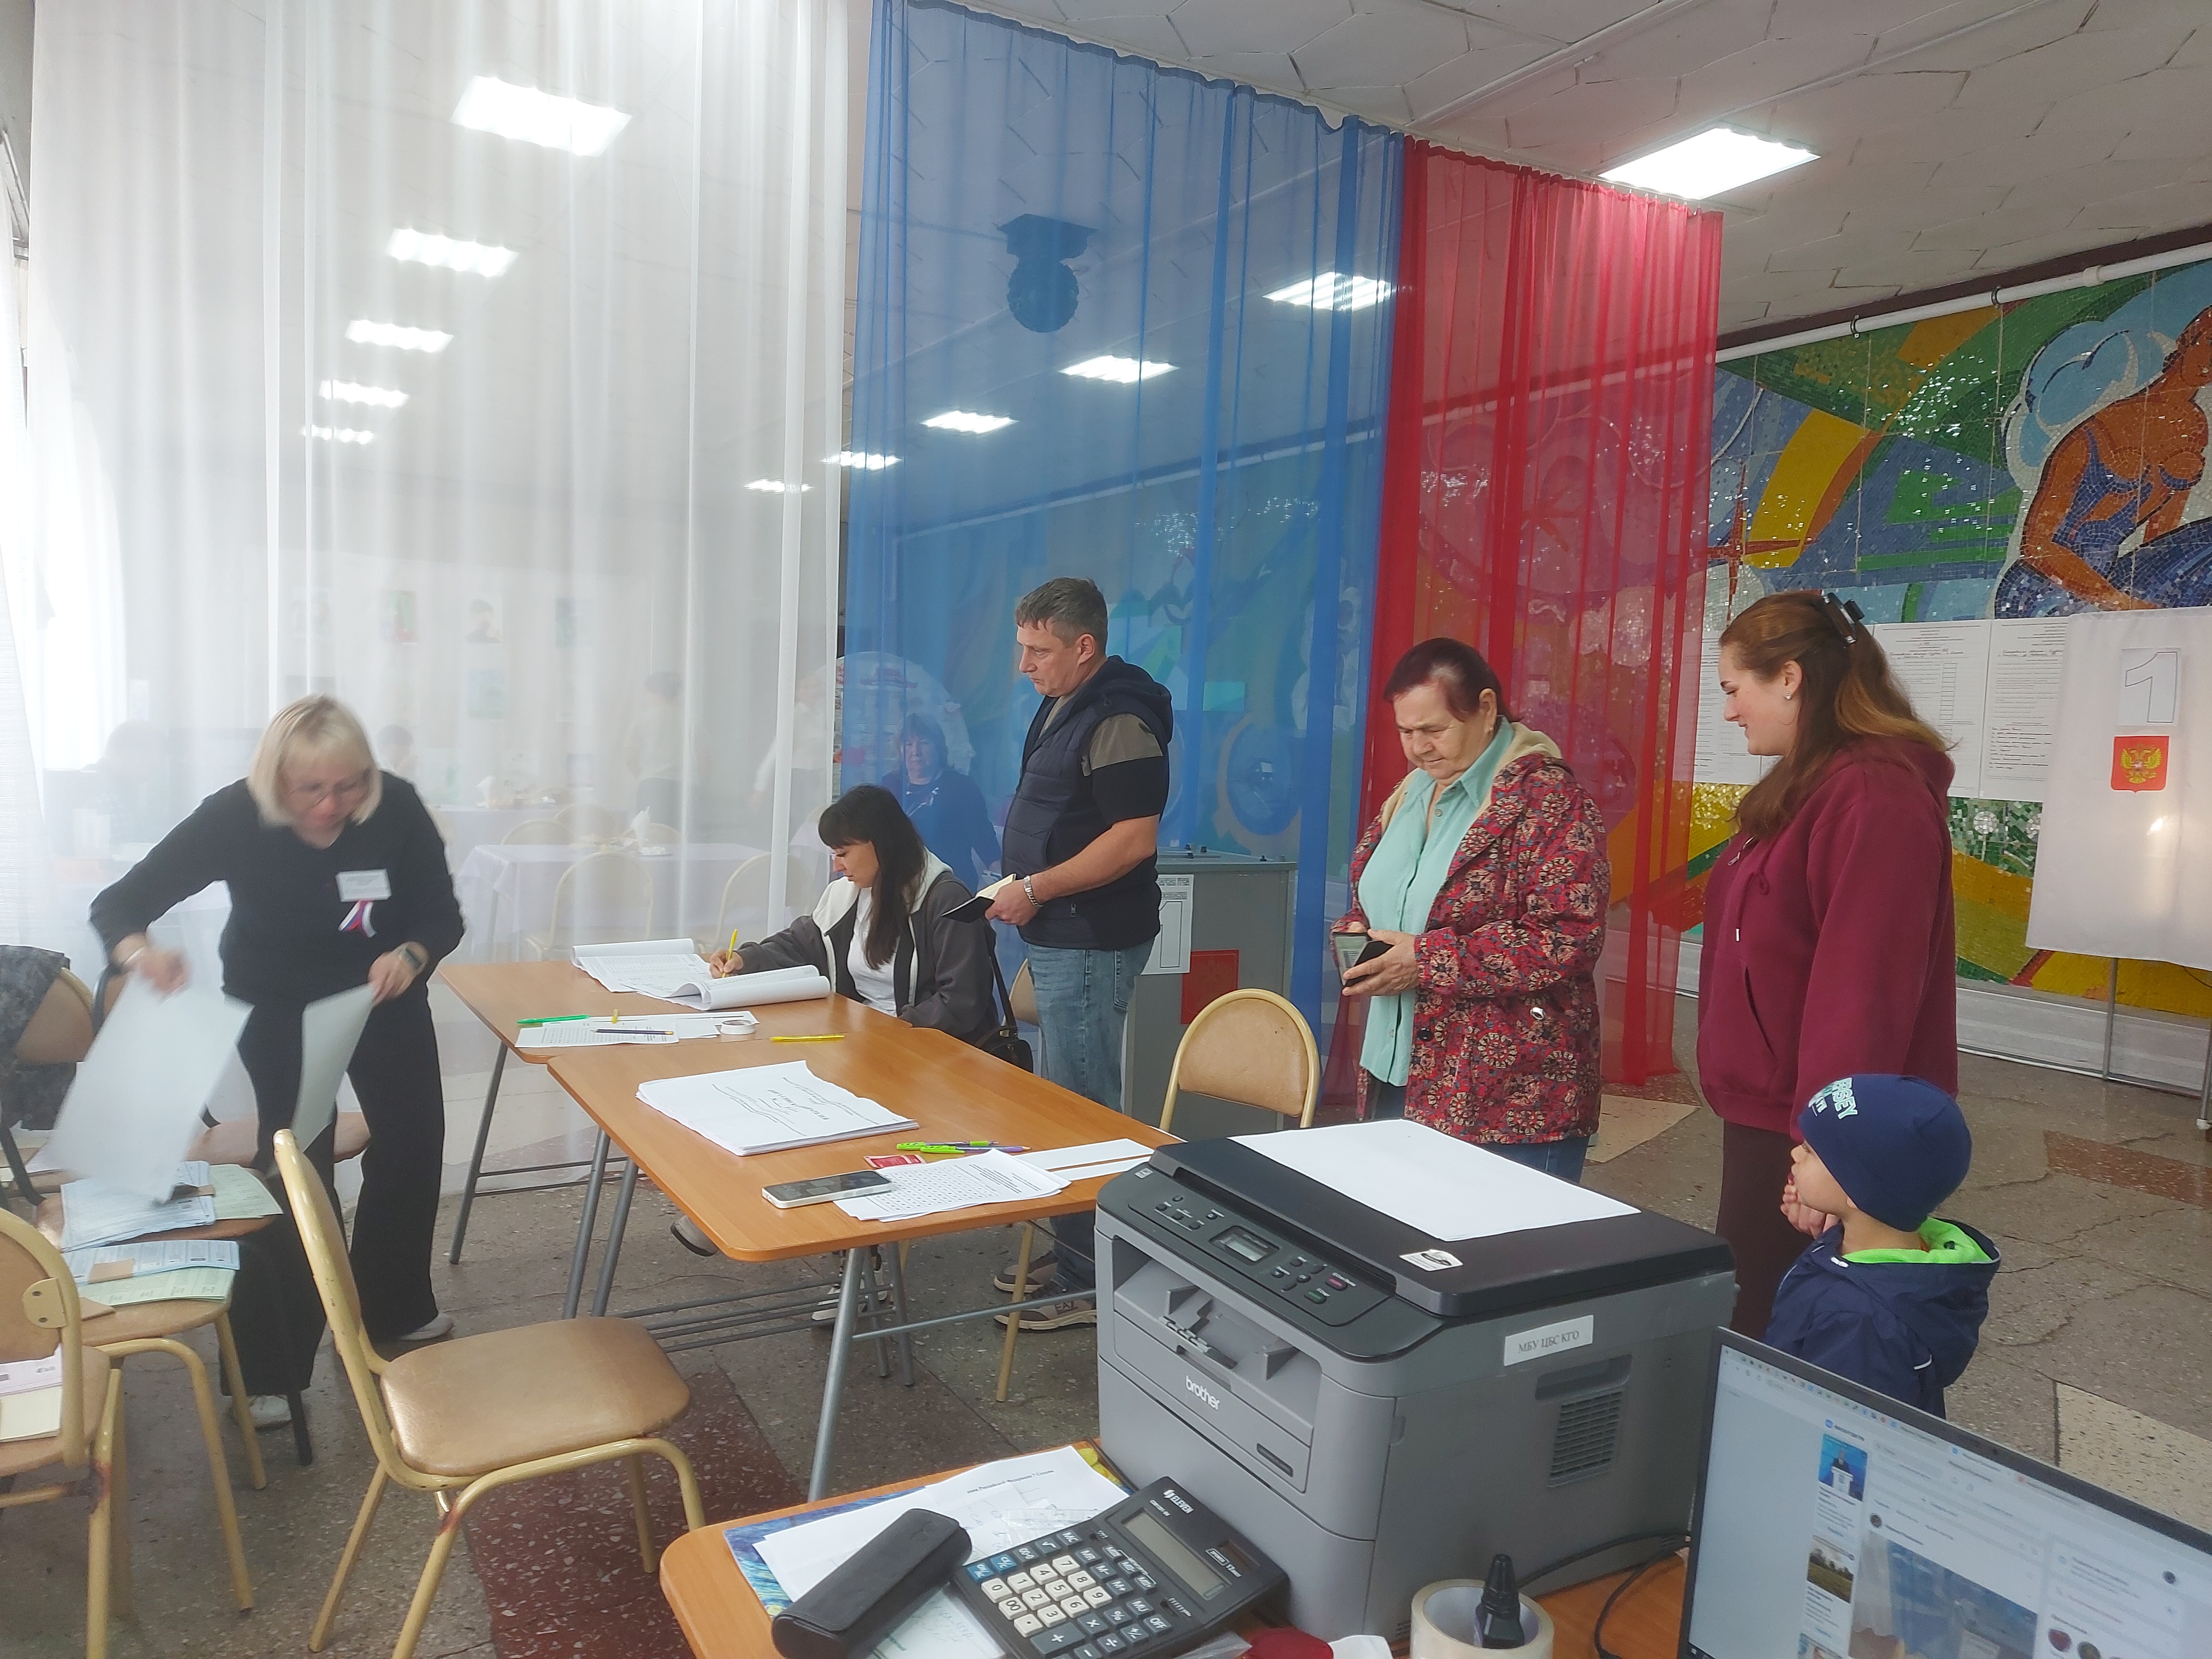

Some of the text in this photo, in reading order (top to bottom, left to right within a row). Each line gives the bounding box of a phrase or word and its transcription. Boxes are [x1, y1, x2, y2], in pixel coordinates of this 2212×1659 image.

[2125, 652, 2178, 723] 1
[1186, 1375, 1220, 1410] brother
[1170, 1495, 1194, 1514] ELEVEN
[1062, 1532, 1079, 1543] MC
[1080, 1550, 1095, 1560] MR
[1006, 1600, 1021, 1611] 00
[1132, 1601, 1149, 1612] MU
[1150, 1618, 1168, 1628] OFF
